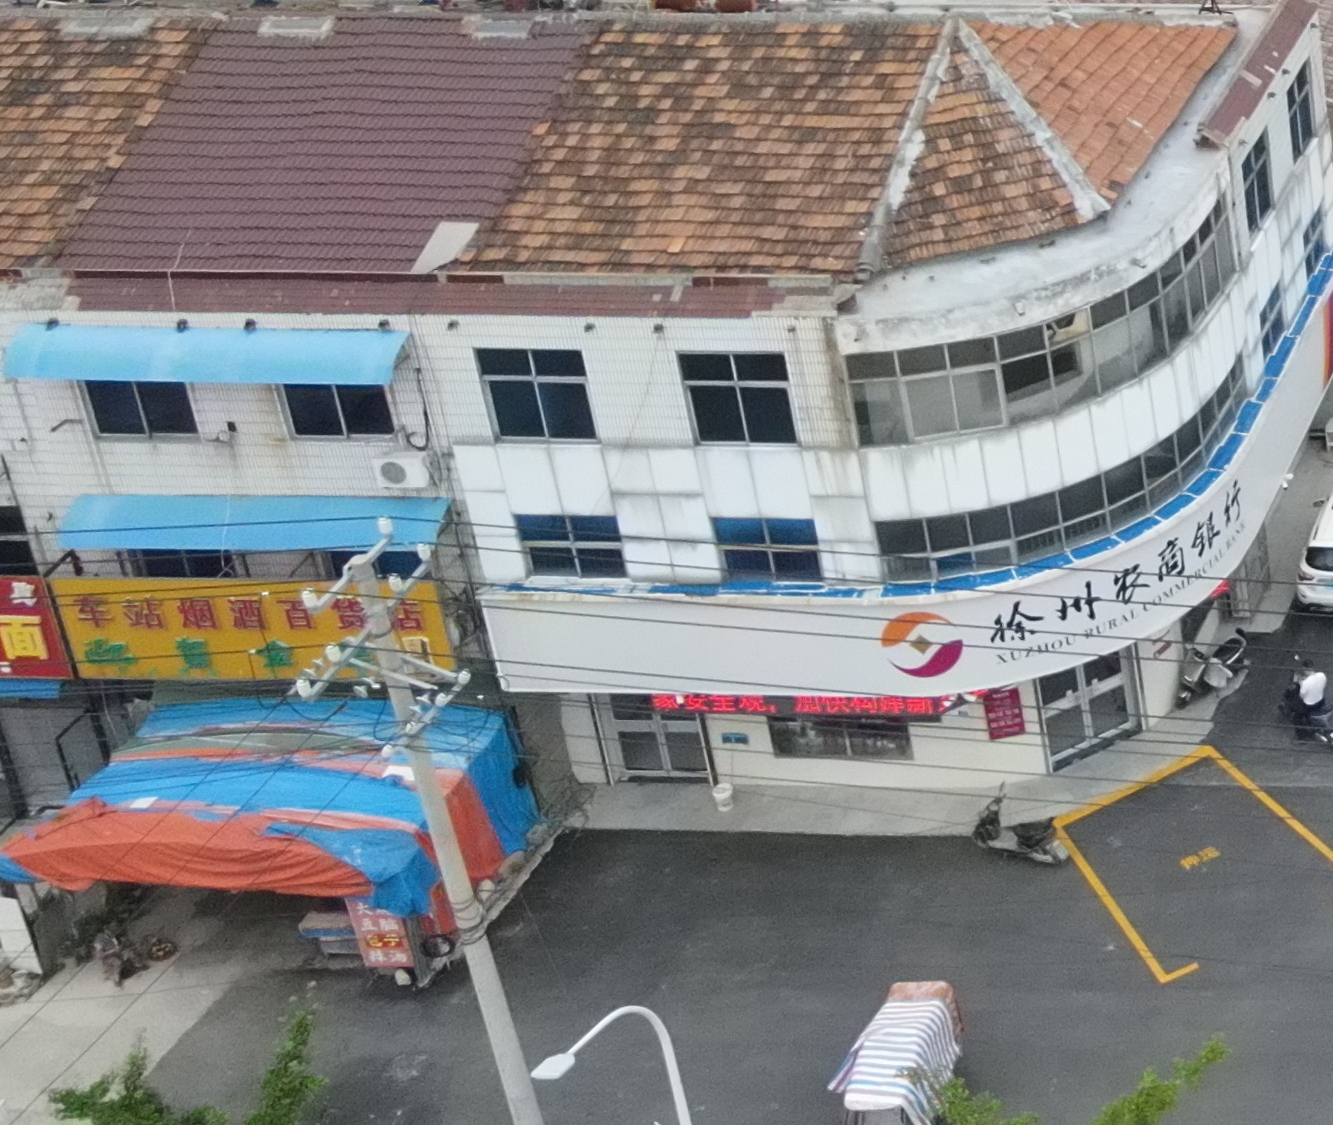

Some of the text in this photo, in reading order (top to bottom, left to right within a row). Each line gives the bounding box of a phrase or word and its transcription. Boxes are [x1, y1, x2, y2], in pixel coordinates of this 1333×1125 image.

[75, 596, 424, 631] 车站烟酒百货店
[990, 479, 1242, 643] 徐州农商银行
[996, 631, 1078, 665] XUZHOU
[1084, 610, 1140, 639] RURAL
[1143, 549, 1223, 612] COMMERCIAL
